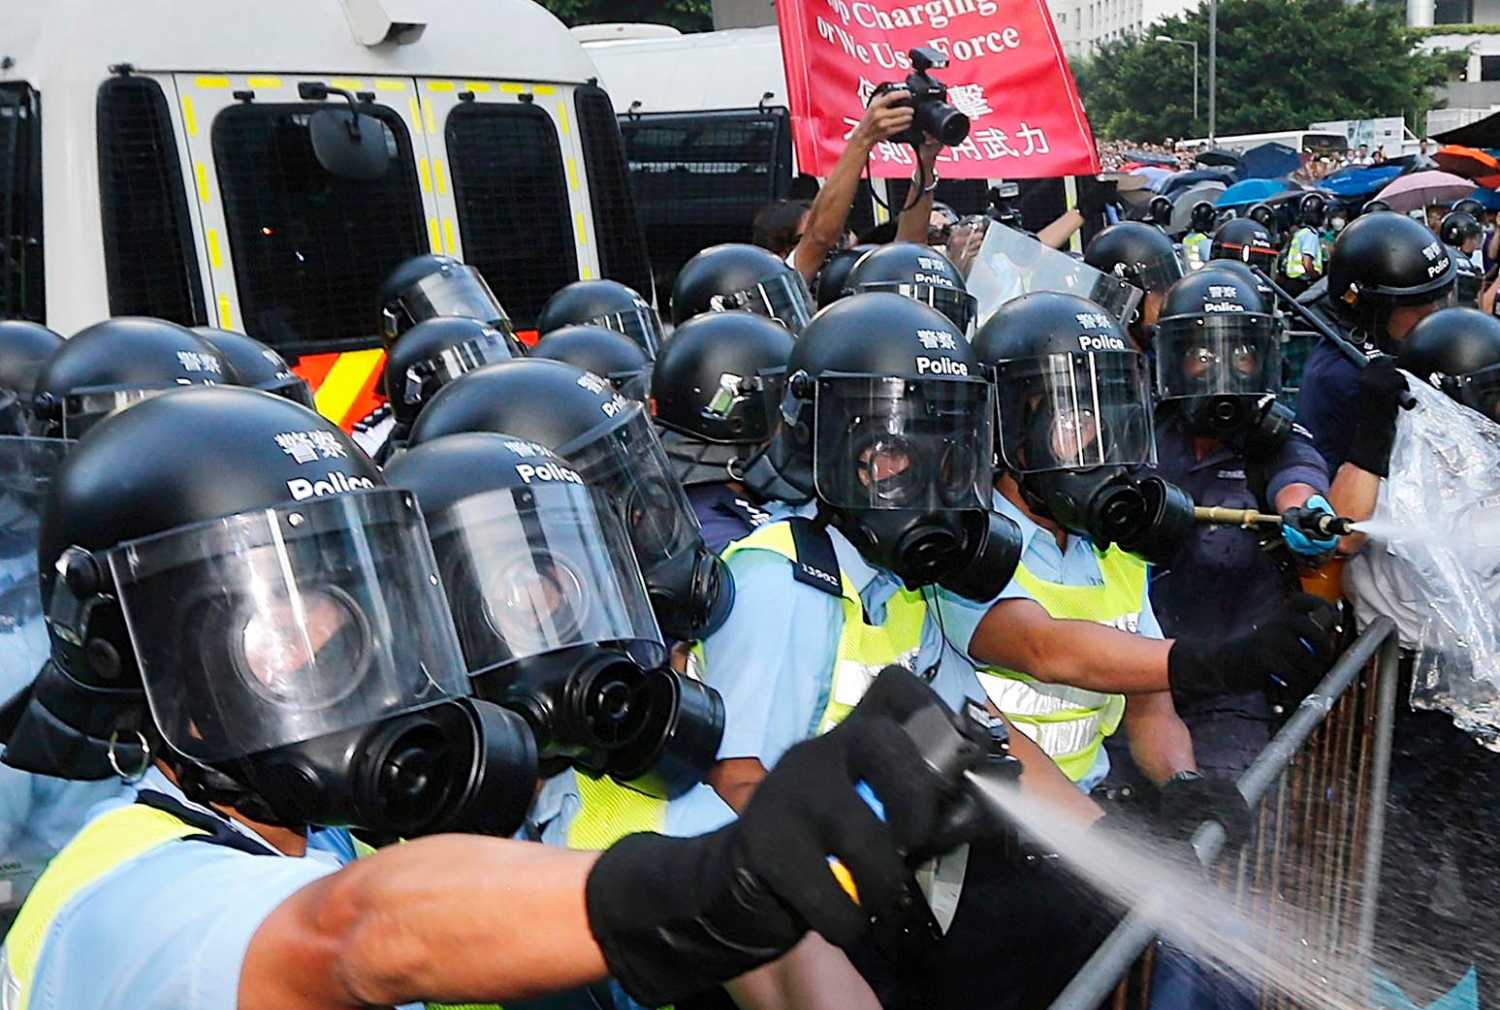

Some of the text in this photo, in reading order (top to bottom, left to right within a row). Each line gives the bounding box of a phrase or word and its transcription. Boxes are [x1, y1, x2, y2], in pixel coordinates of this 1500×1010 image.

[852, 0, 997, 29] Charging
[869, 42, 912, 69] Us
[916, 356, 968, 376] Police
